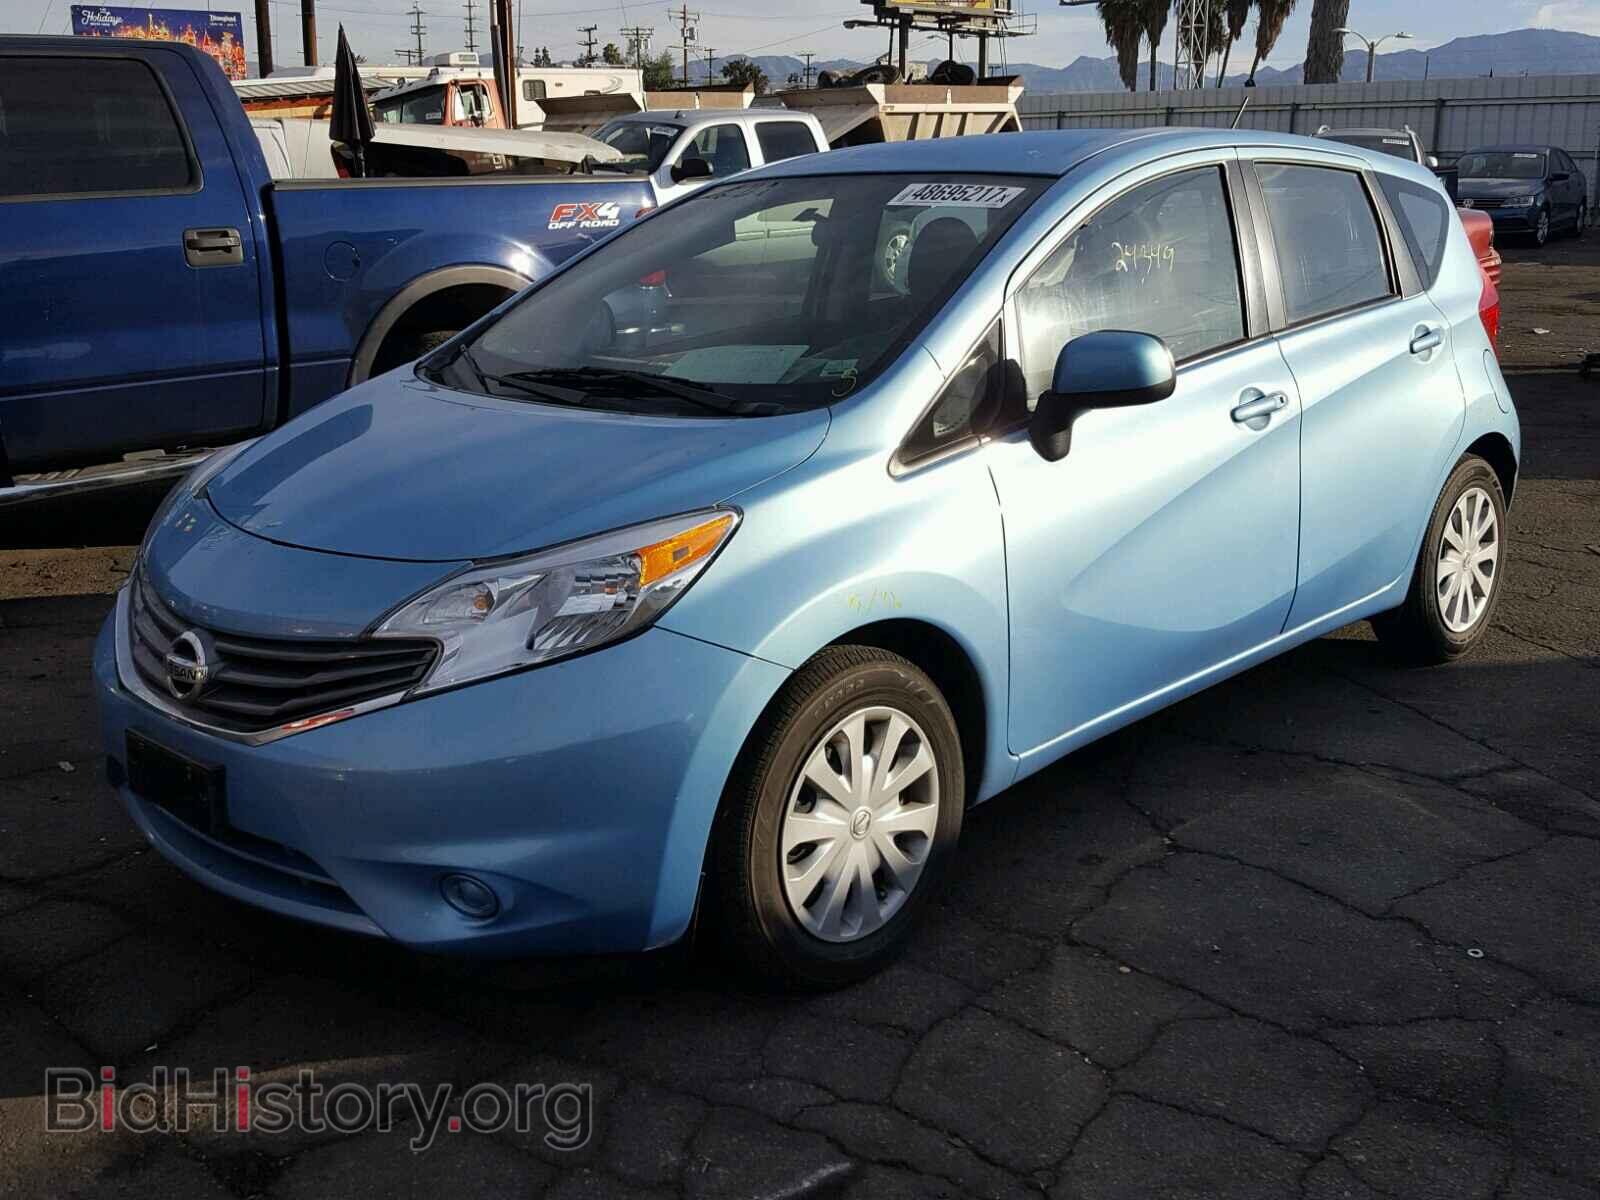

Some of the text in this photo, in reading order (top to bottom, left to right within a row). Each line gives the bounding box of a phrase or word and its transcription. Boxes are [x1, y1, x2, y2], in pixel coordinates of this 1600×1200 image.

[911, 184, 1008, 202] 48695217
[550, 201, 620, 222] FX4
[548, 219, 619, 230] OFF ROAD
